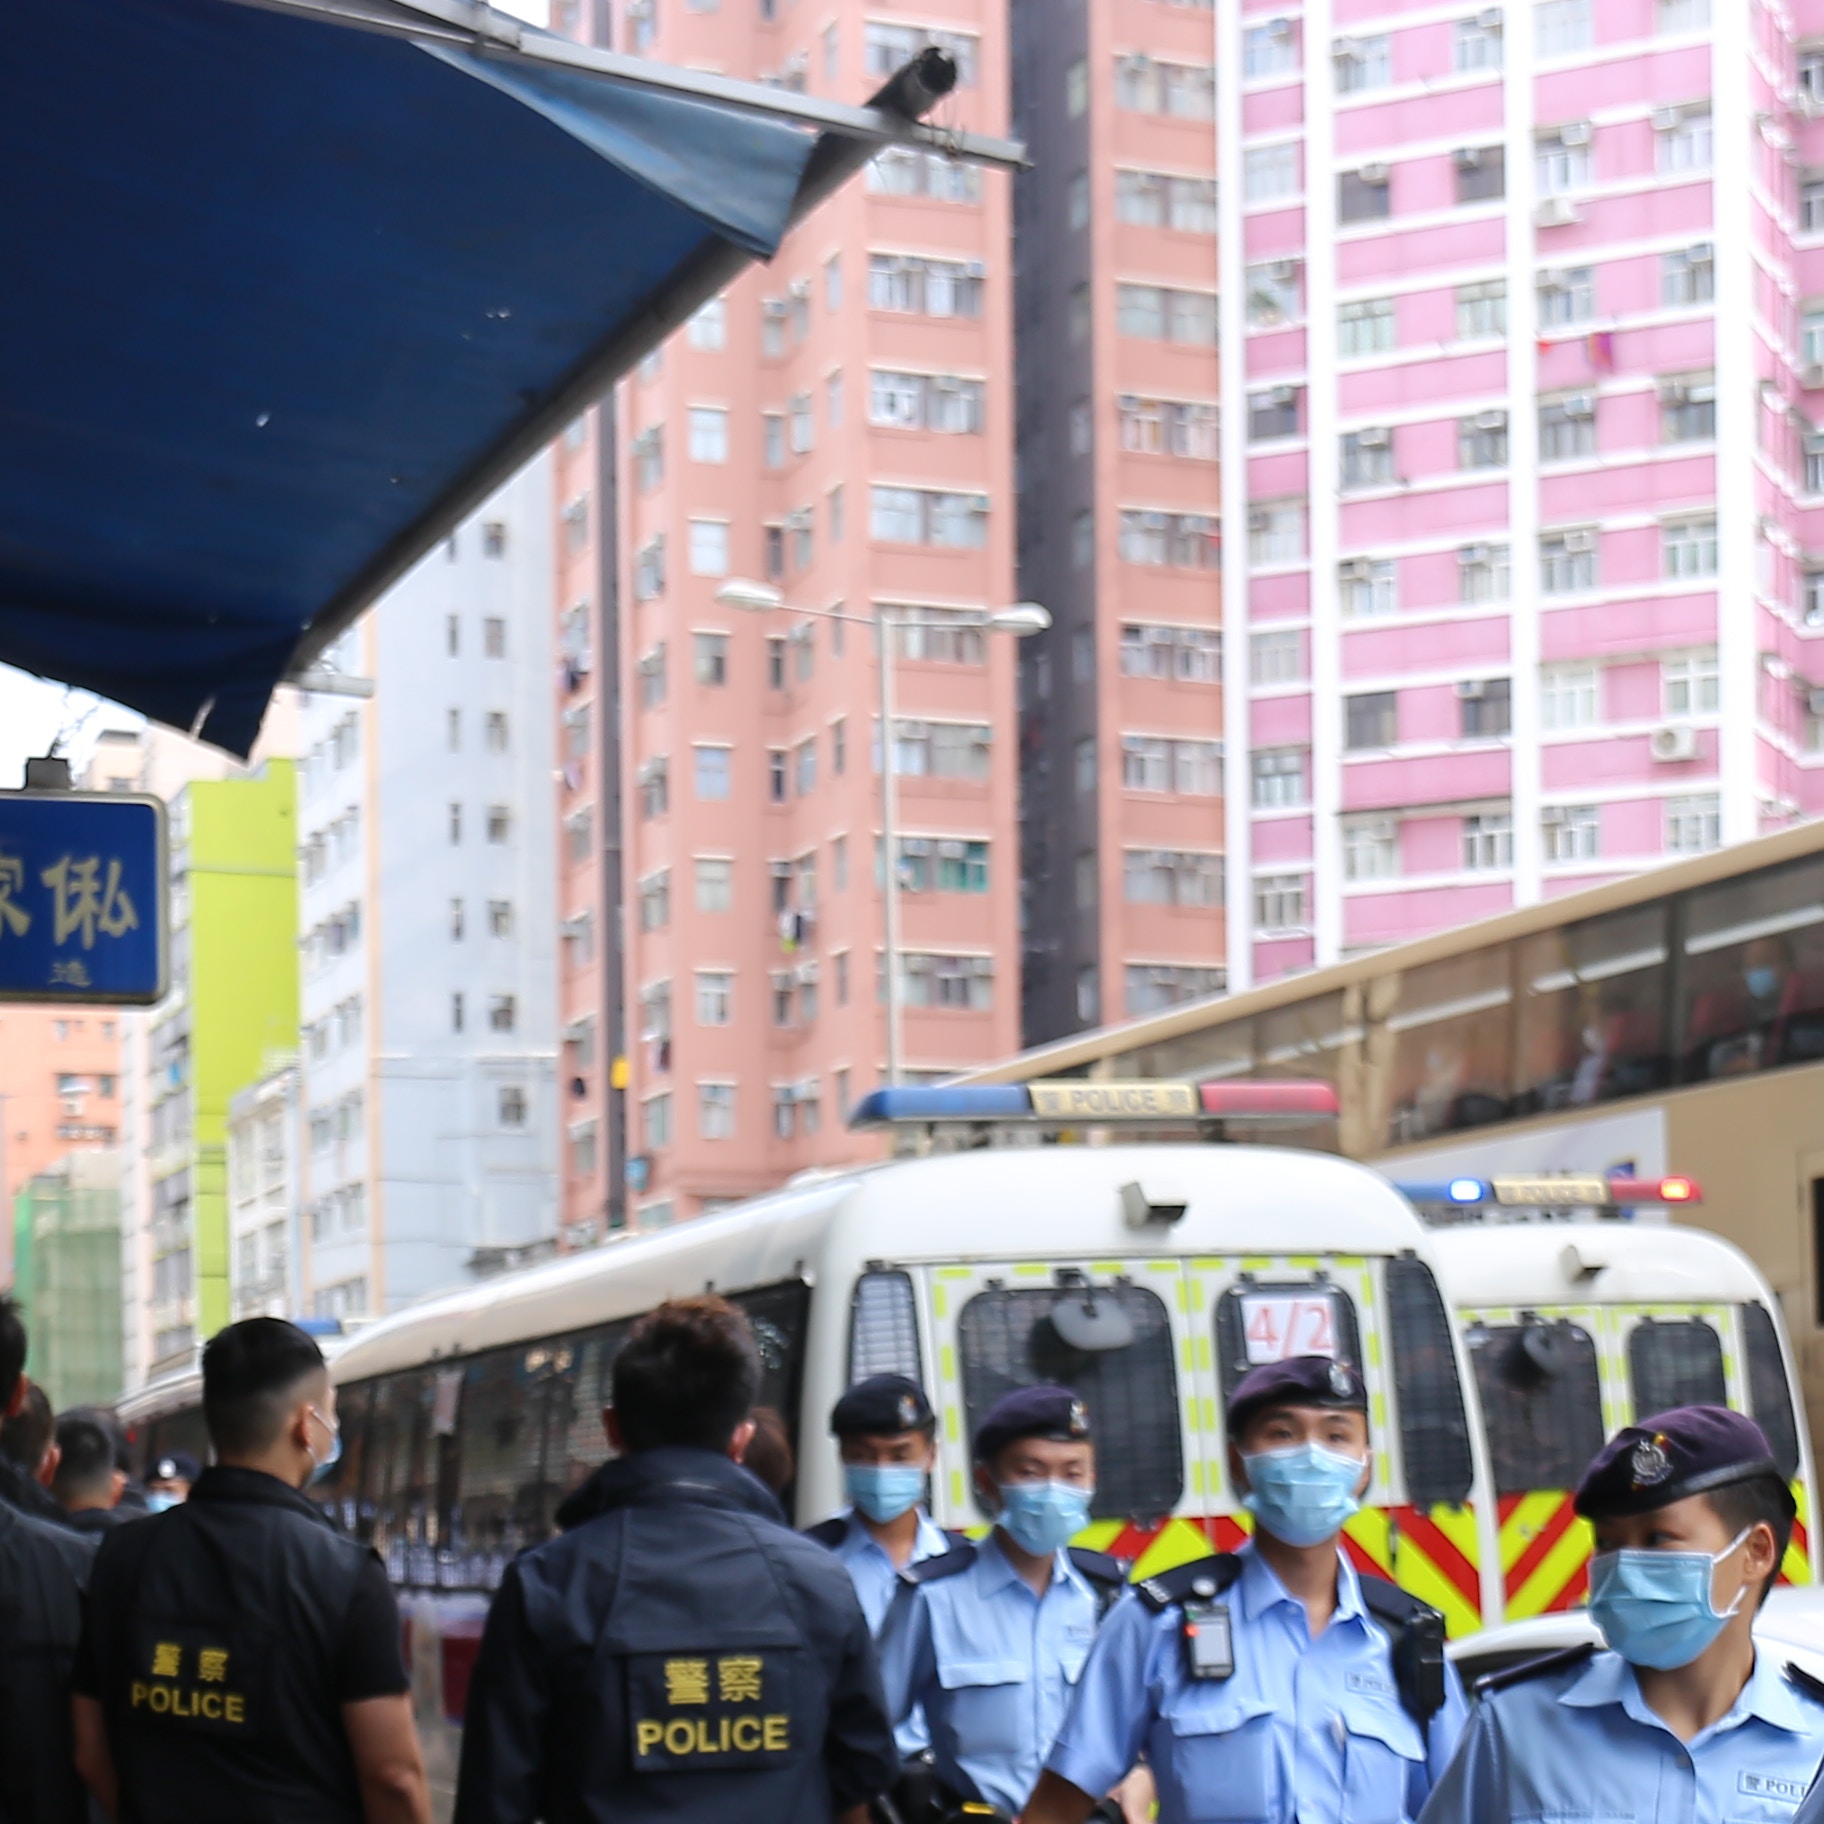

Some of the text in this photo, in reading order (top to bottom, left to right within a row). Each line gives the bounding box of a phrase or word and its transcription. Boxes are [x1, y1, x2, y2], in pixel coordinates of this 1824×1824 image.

[1071, 1089, 1157, 1111] POLICE
[1247, 1301, 1334, 1358] 4/2
[151, 1641, 230, 1684] 警察
[663, 1656, 765, 1706] 警察
[131, 1682, 245, 1725] POLICE
[635, 1714, 791, 1757] POLICE
